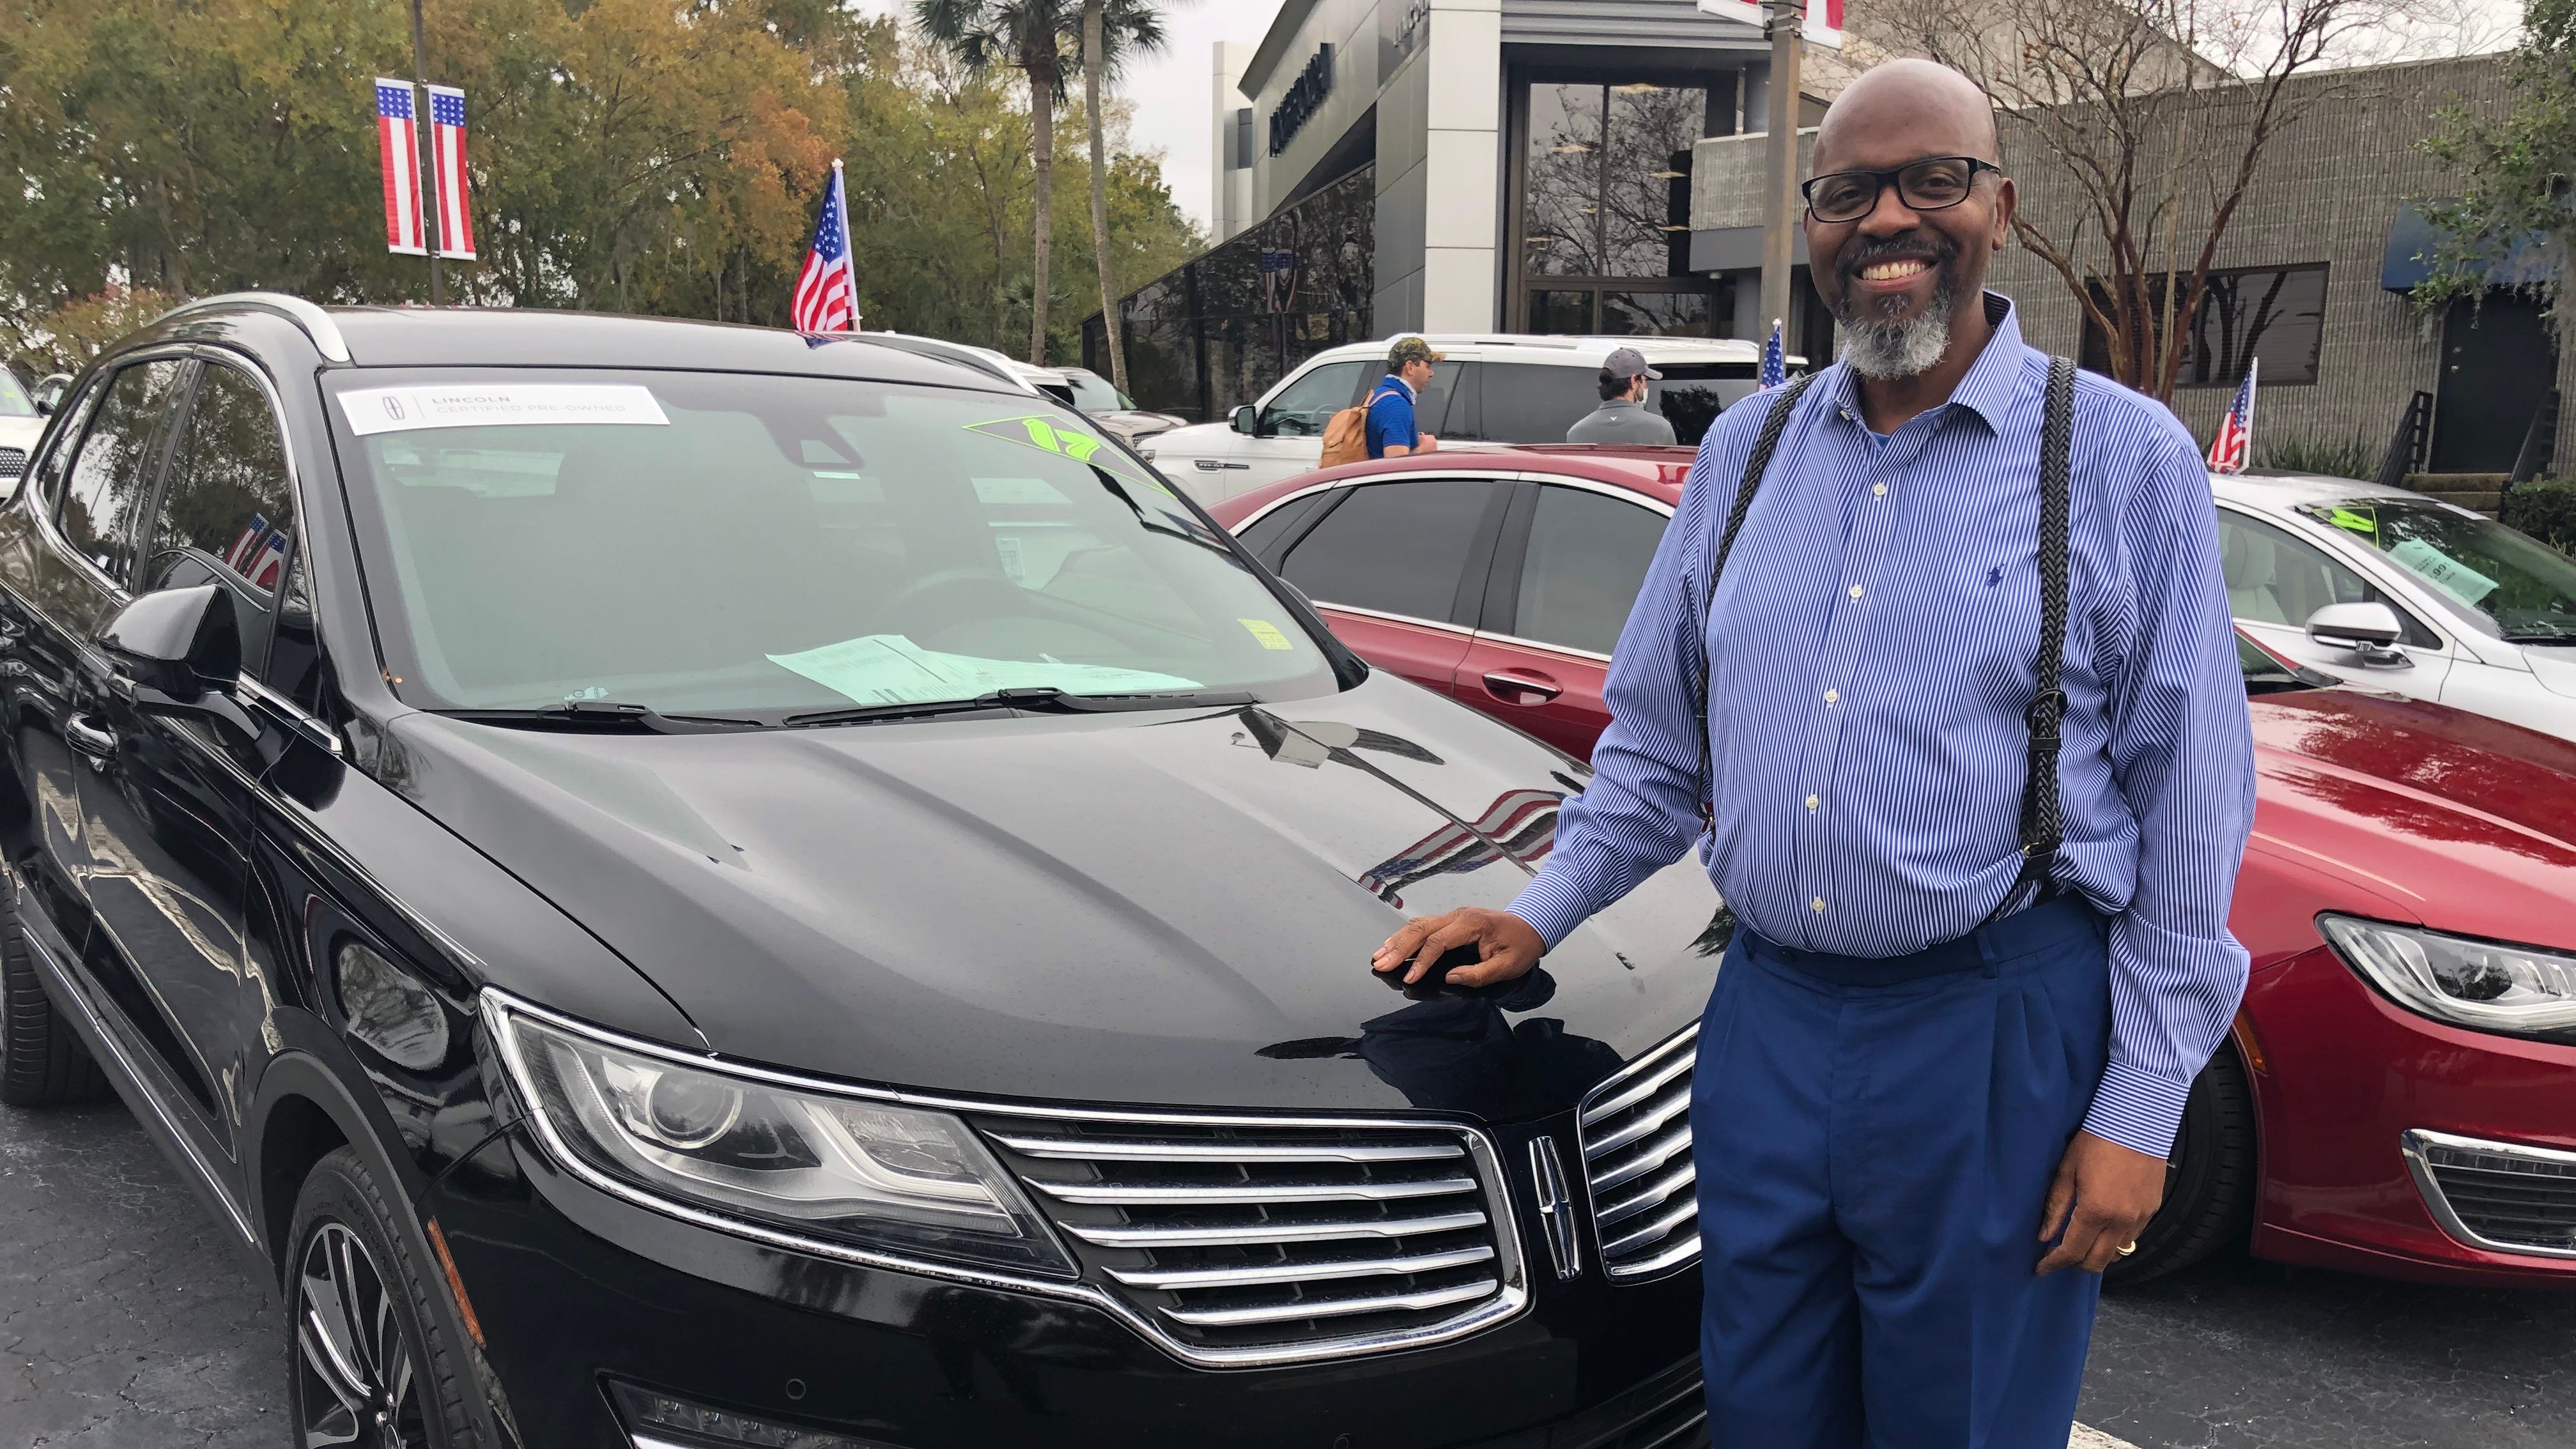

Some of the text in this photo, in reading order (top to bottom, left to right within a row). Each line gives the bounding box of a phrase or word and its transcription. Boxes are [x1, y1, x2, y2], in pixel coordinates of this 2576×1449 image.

[432, 396, 511, 404] LINCOLN
[437, 404, 626, 413] CERTIFIED PRE-OWNED
[1021, 418, 1100, 461] 17
